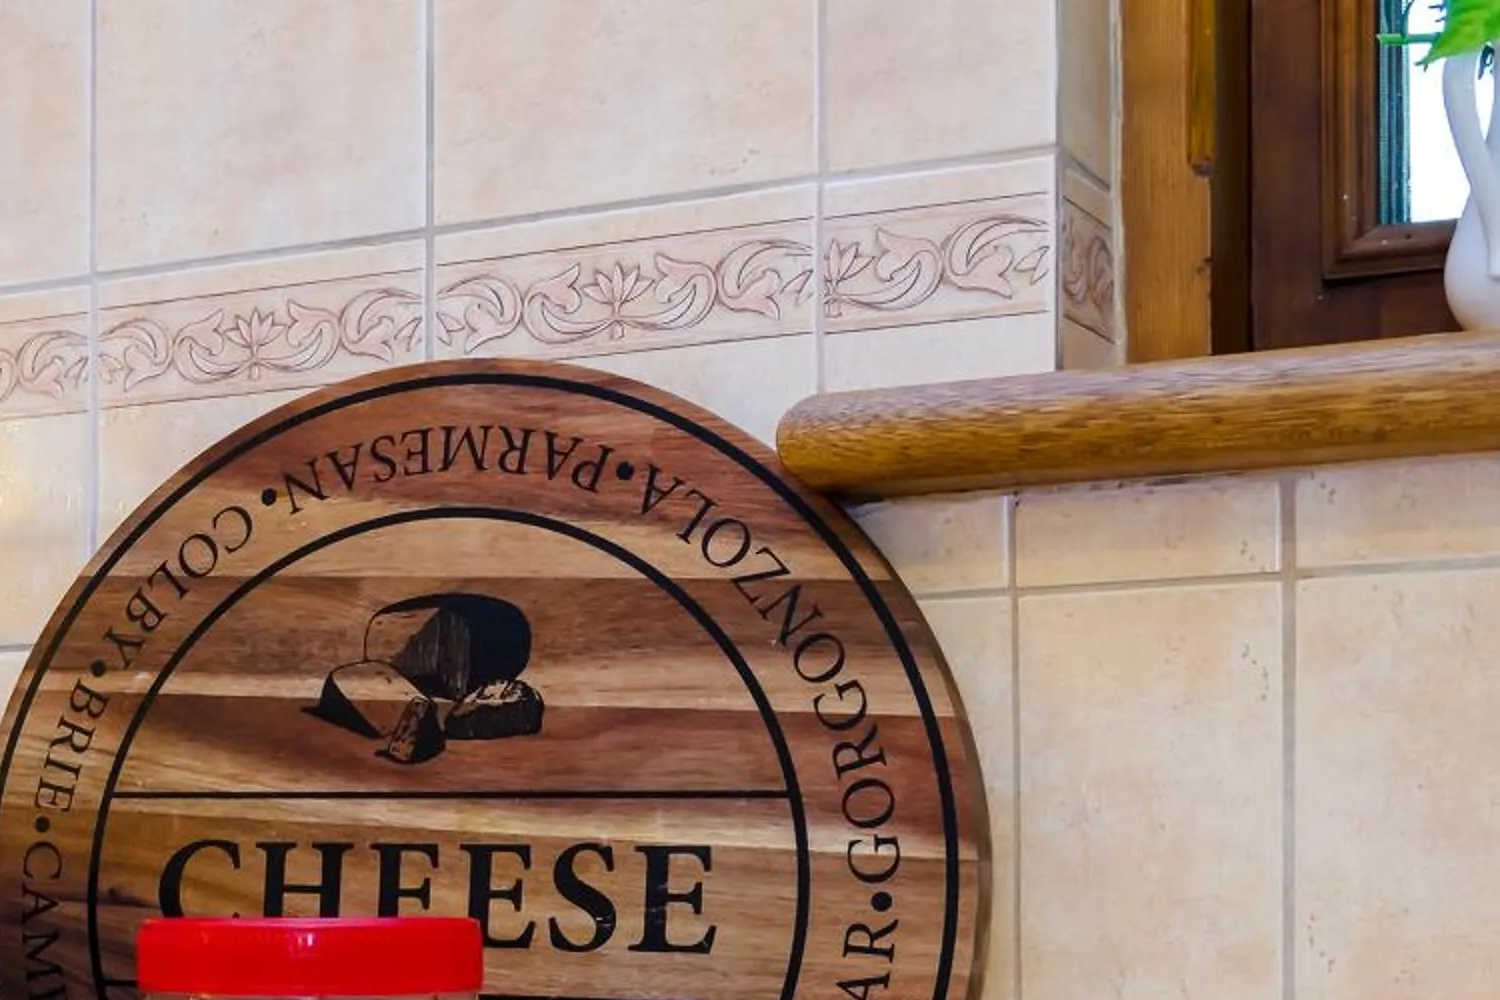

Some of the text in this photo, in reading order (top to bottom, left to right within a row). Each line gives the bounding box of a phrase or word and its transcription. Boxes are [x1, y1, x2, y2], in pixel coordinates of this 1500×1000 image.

[281, 424, 616, 515] PARMESAN
[102, 505, 253, 671] COLBY
[639, 463, 901, 885] GORGONZOLA
[35, 678, 111, 813] BRIE
[158, 839, 717, 955] CHEESE
